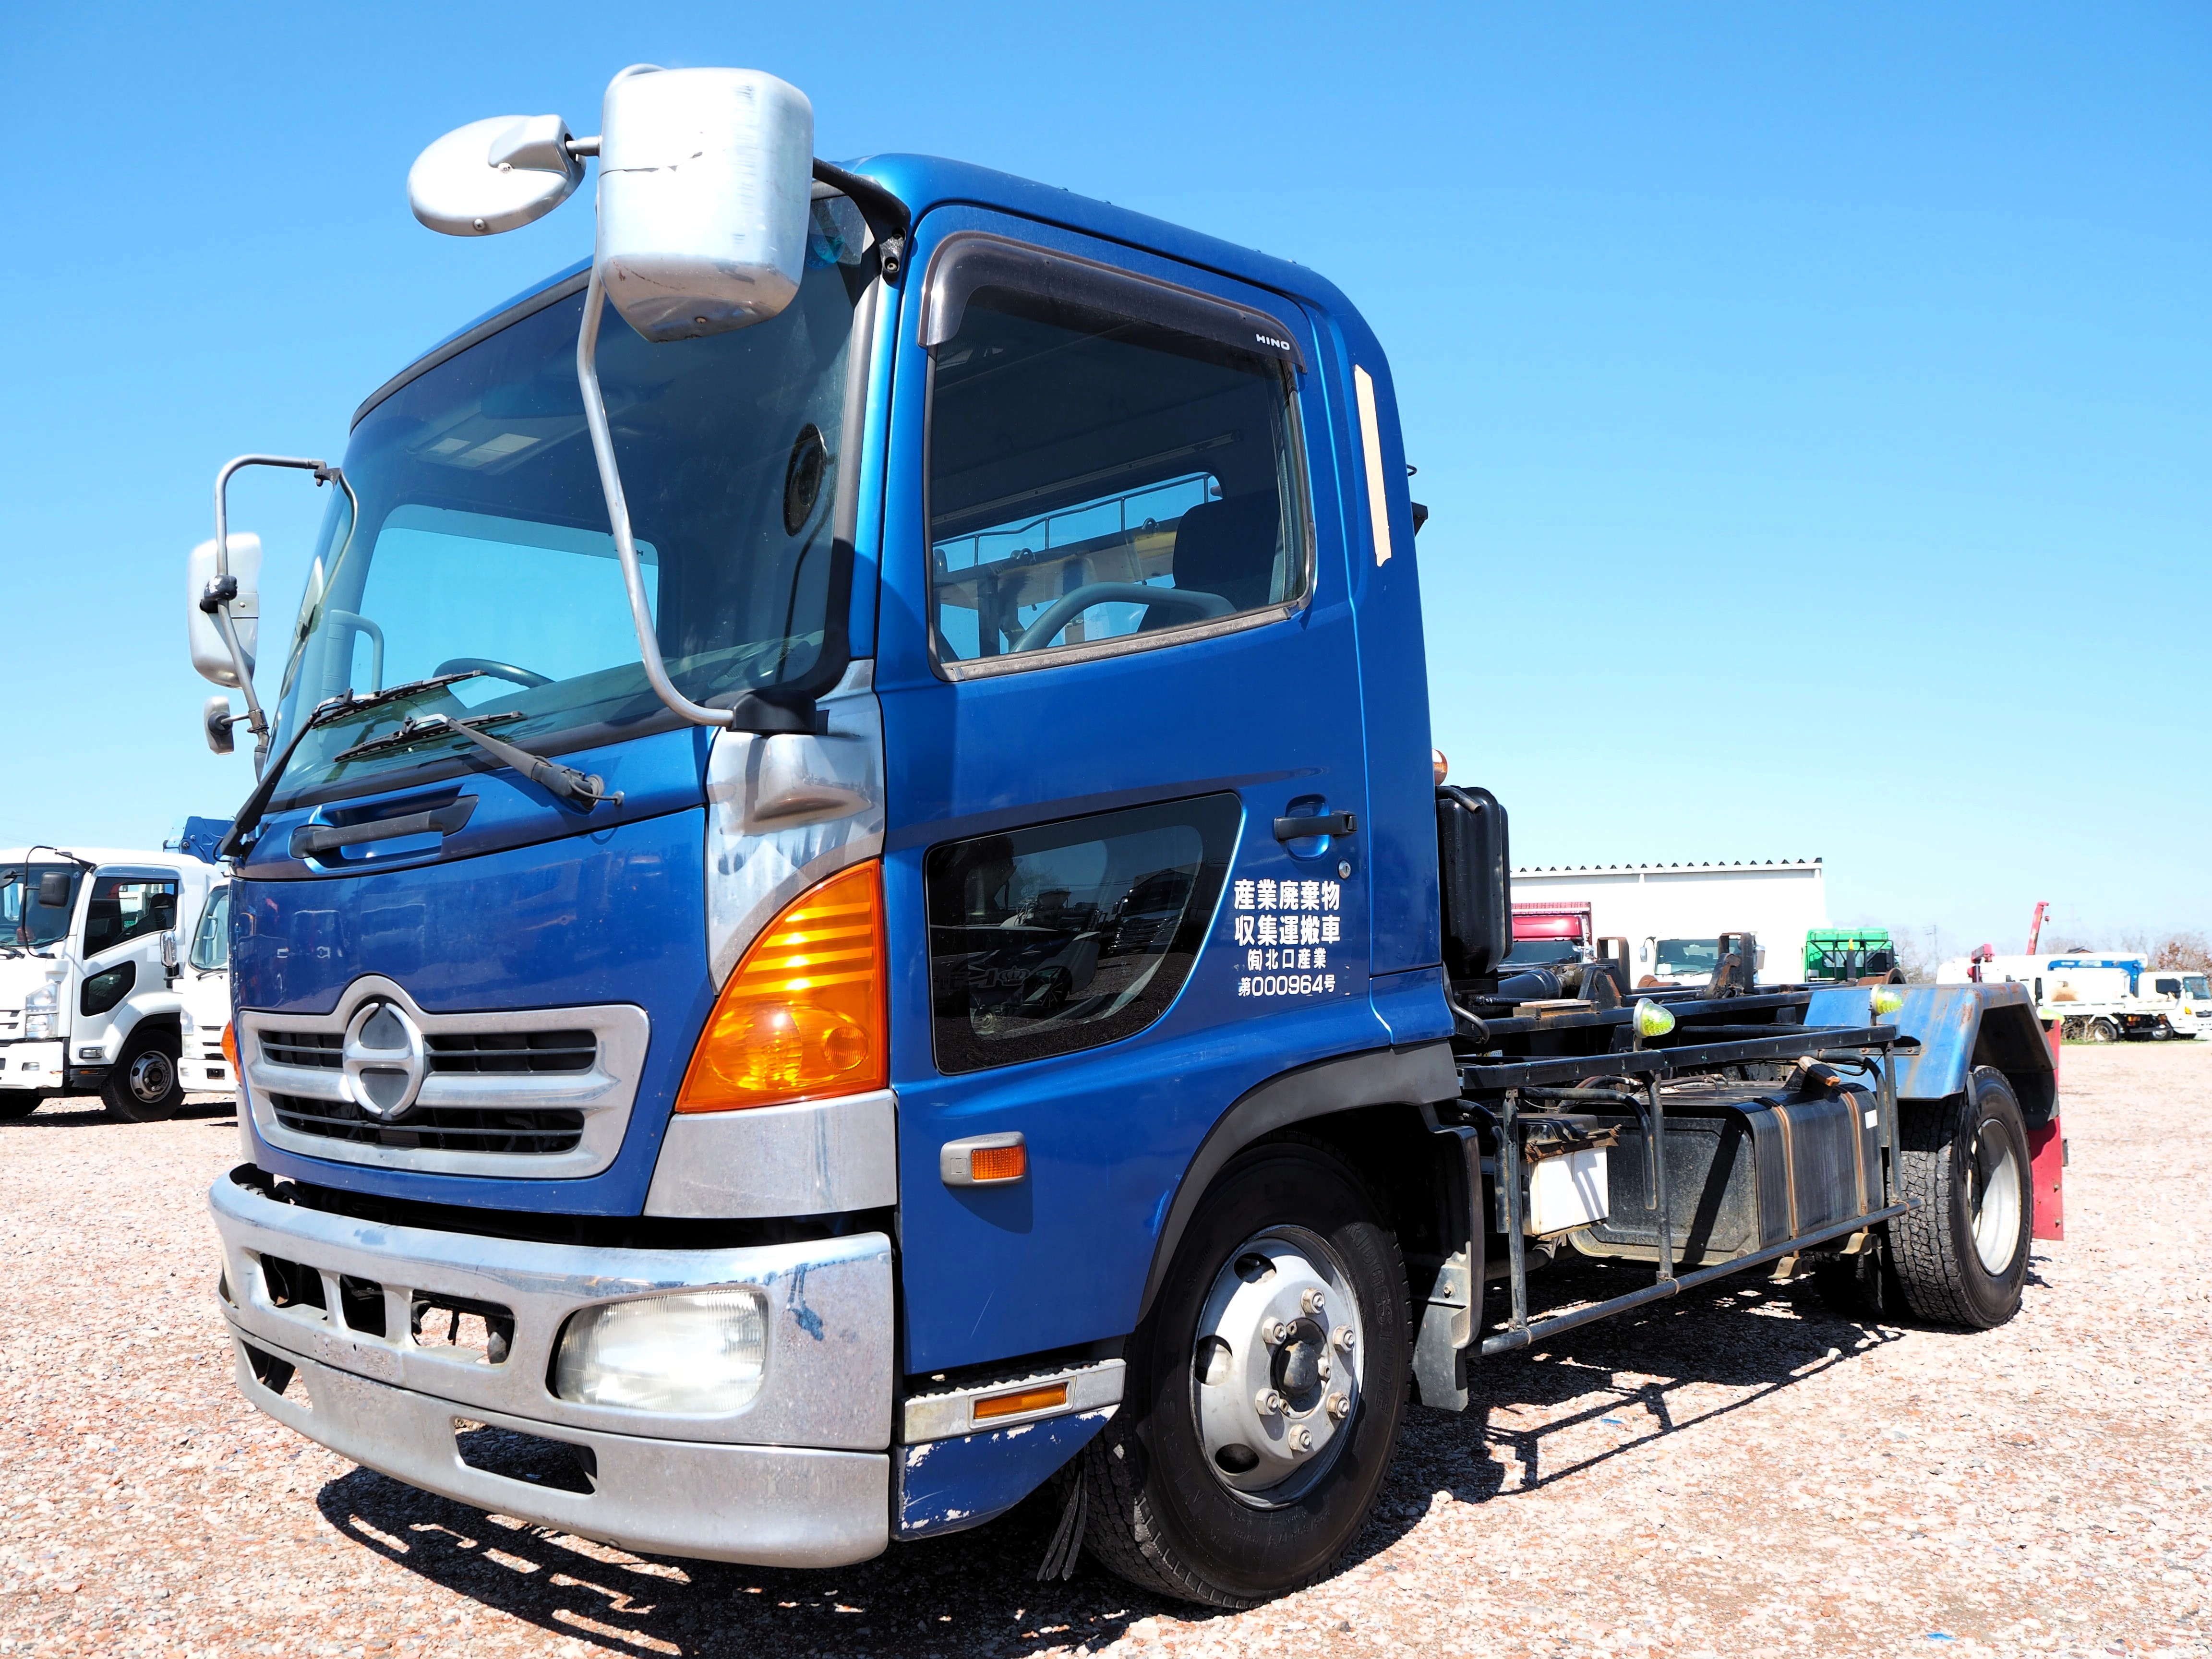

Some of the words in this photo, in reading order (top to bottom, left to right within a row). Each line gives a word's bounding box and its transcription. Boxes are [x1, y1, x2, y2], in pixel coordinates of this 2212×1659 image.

[1256, 334, 1290, 350] HINO
[1234, 879, 1340, 911] 産業廃棄物
[1234, 914, 1341, 946] 収集運搬車
[1238, 974, 1336, 997] 第000964号
[1329, 1195, 1394, 1414] RIDGESTONE
